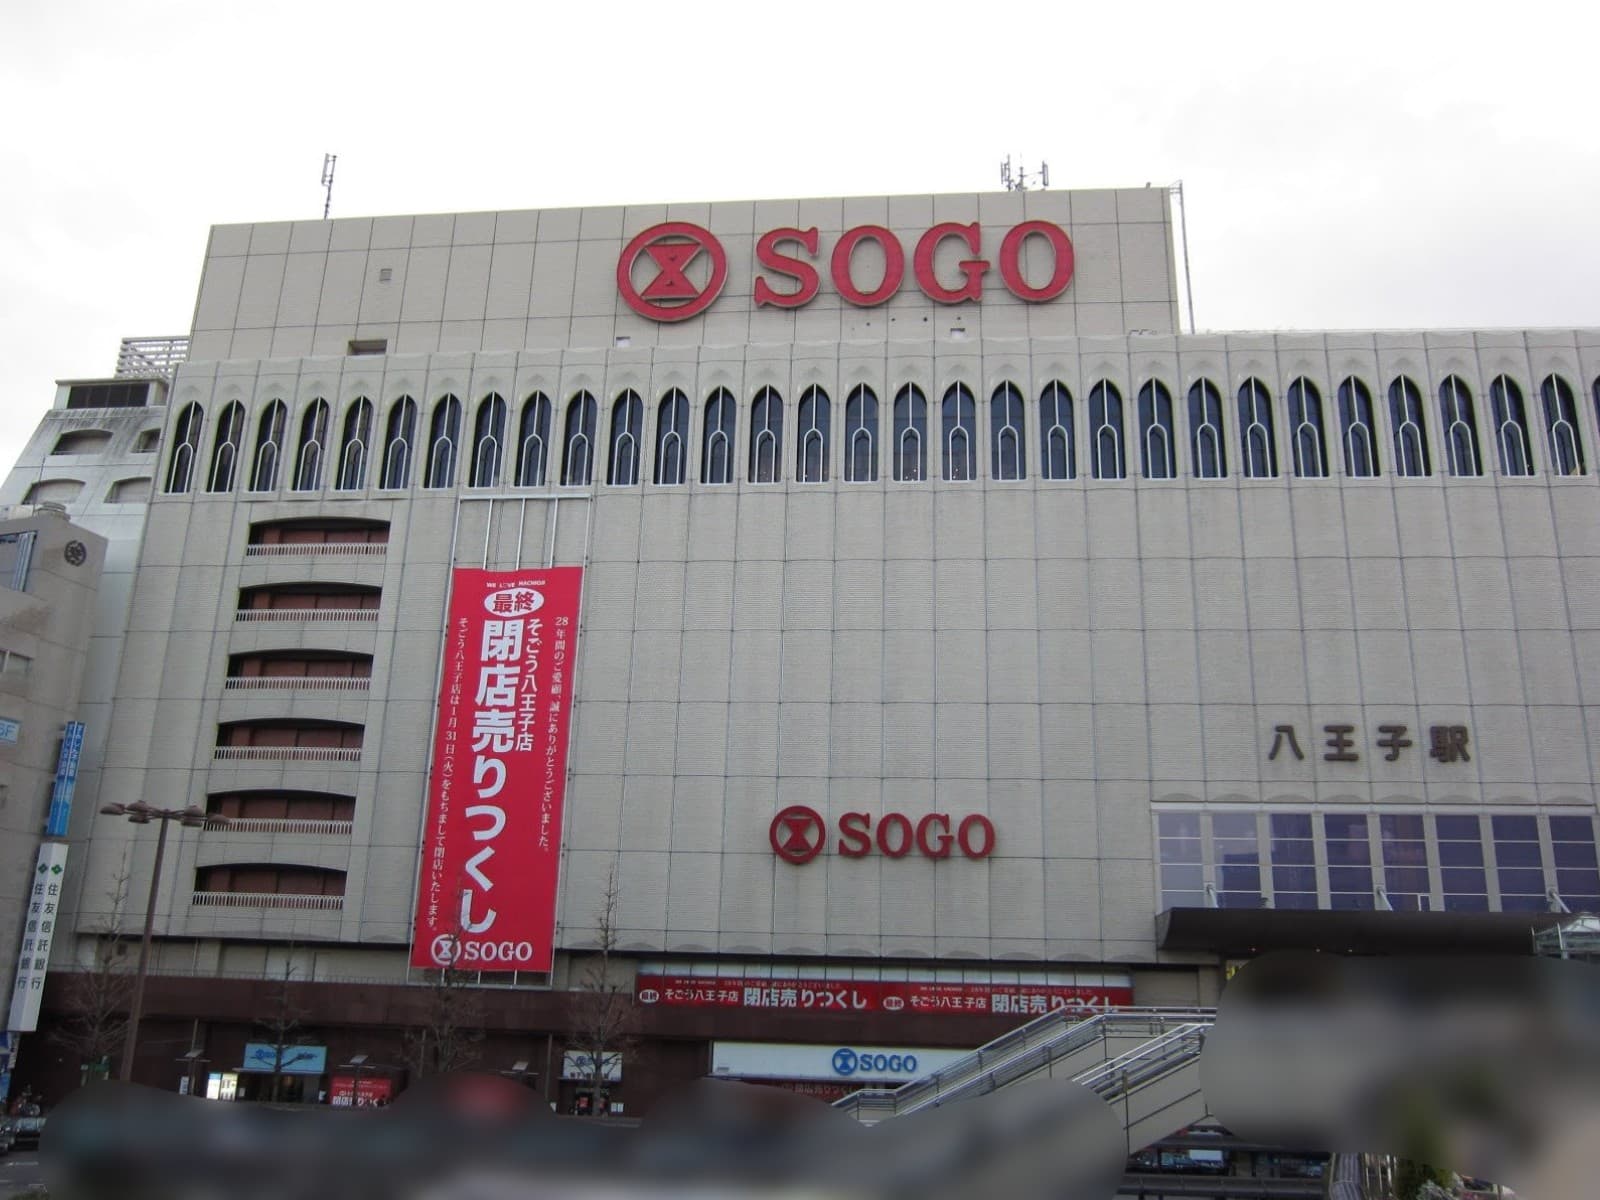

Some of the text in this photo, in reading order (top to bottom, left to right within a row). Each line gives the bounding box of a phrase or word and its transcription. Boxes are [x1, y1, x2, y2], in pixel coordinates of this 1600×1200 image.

[754, 220, 1075, 307] SOGO
[493, 592, 535, 613] 最終
[515, 619, 544, 752] そごう八王子店
[1268, 724, 1471, 762] 八王子駅
[460, 619, 525, 933] 閉店売りつくし
[838, 812, 996, 860] SOGO
[31, 884, 58, 990] 住友信託銀行
[464, 941, 532, 962] SOGO
[744, 987, 867, 1009] 閉店売りつくし
[860, 1054, 917, 1073] SOGO
